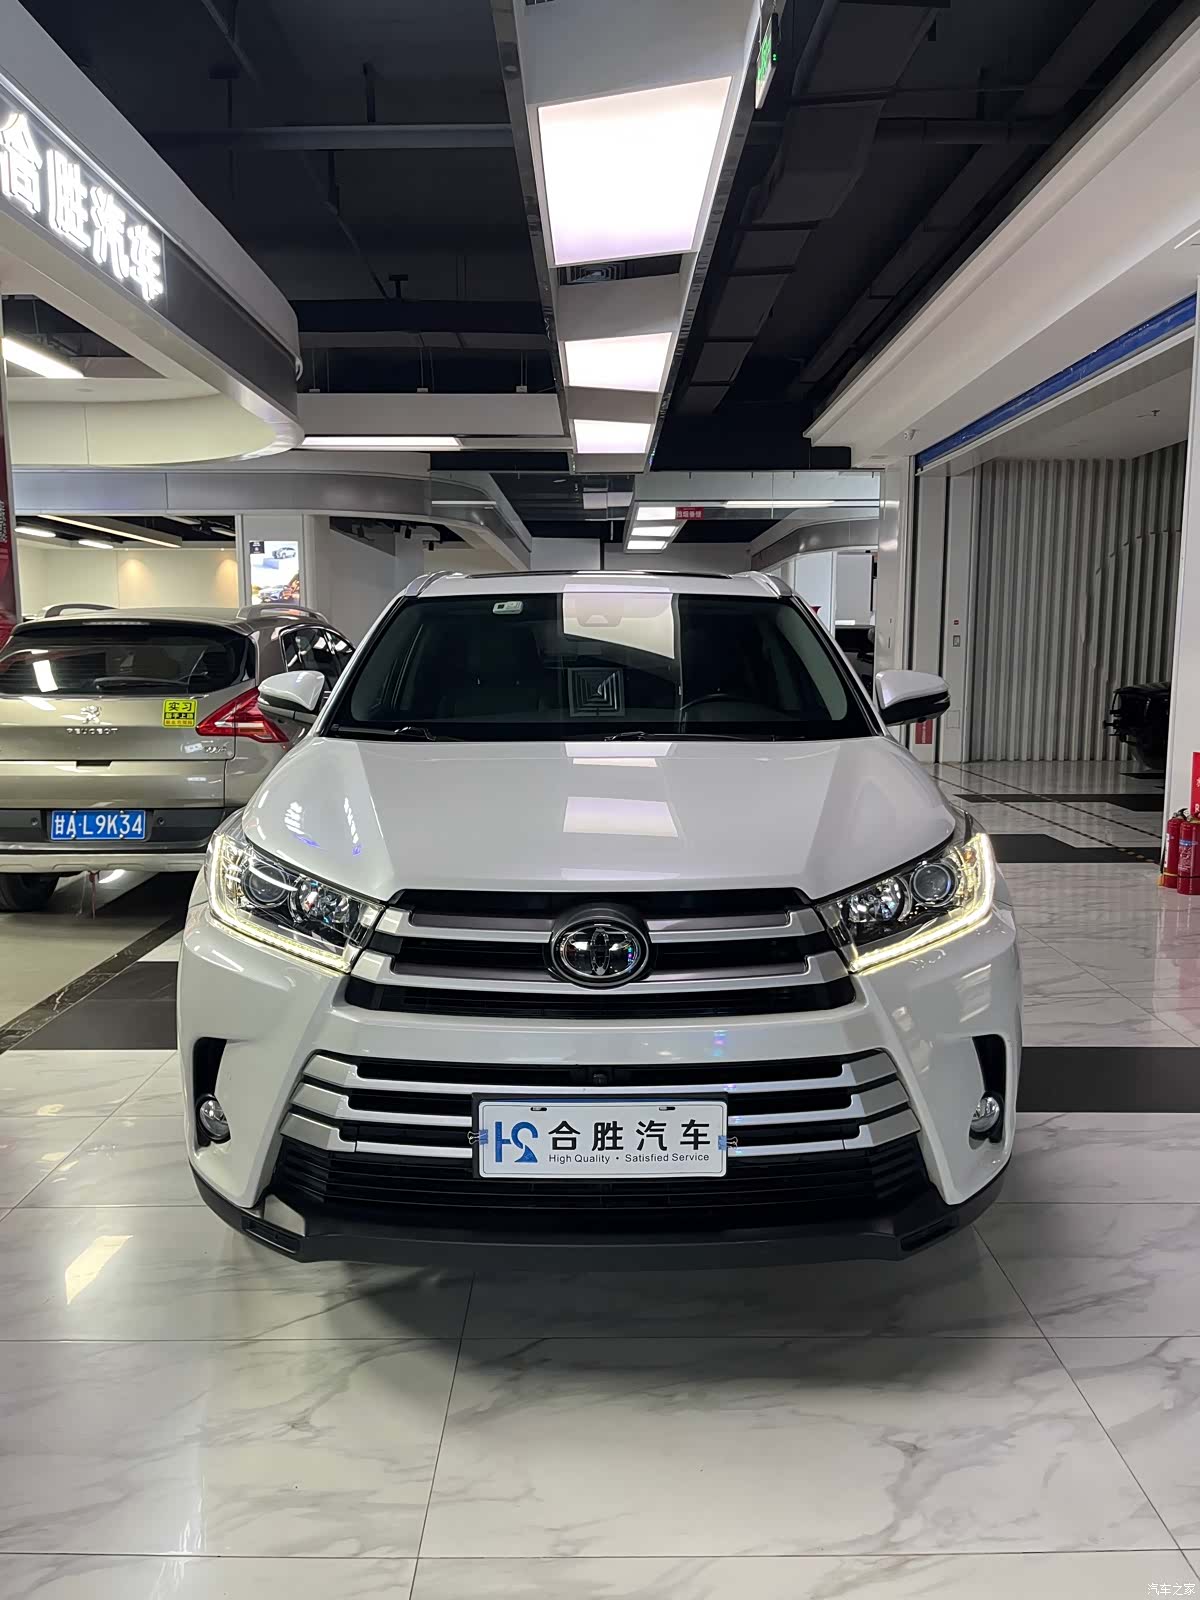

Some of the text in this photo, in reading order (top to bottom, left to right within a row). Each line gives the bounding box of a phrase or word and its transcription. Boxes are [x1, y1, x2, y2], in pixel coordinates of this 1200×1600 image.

[0, 112, 164, 302] 合胜汽车
[168, 701, 193, 712] 实习
[548, 1119, 711, 1152] 合胜汽车
[548, 1153, 710, 1165] High Quality Satisfied Service
